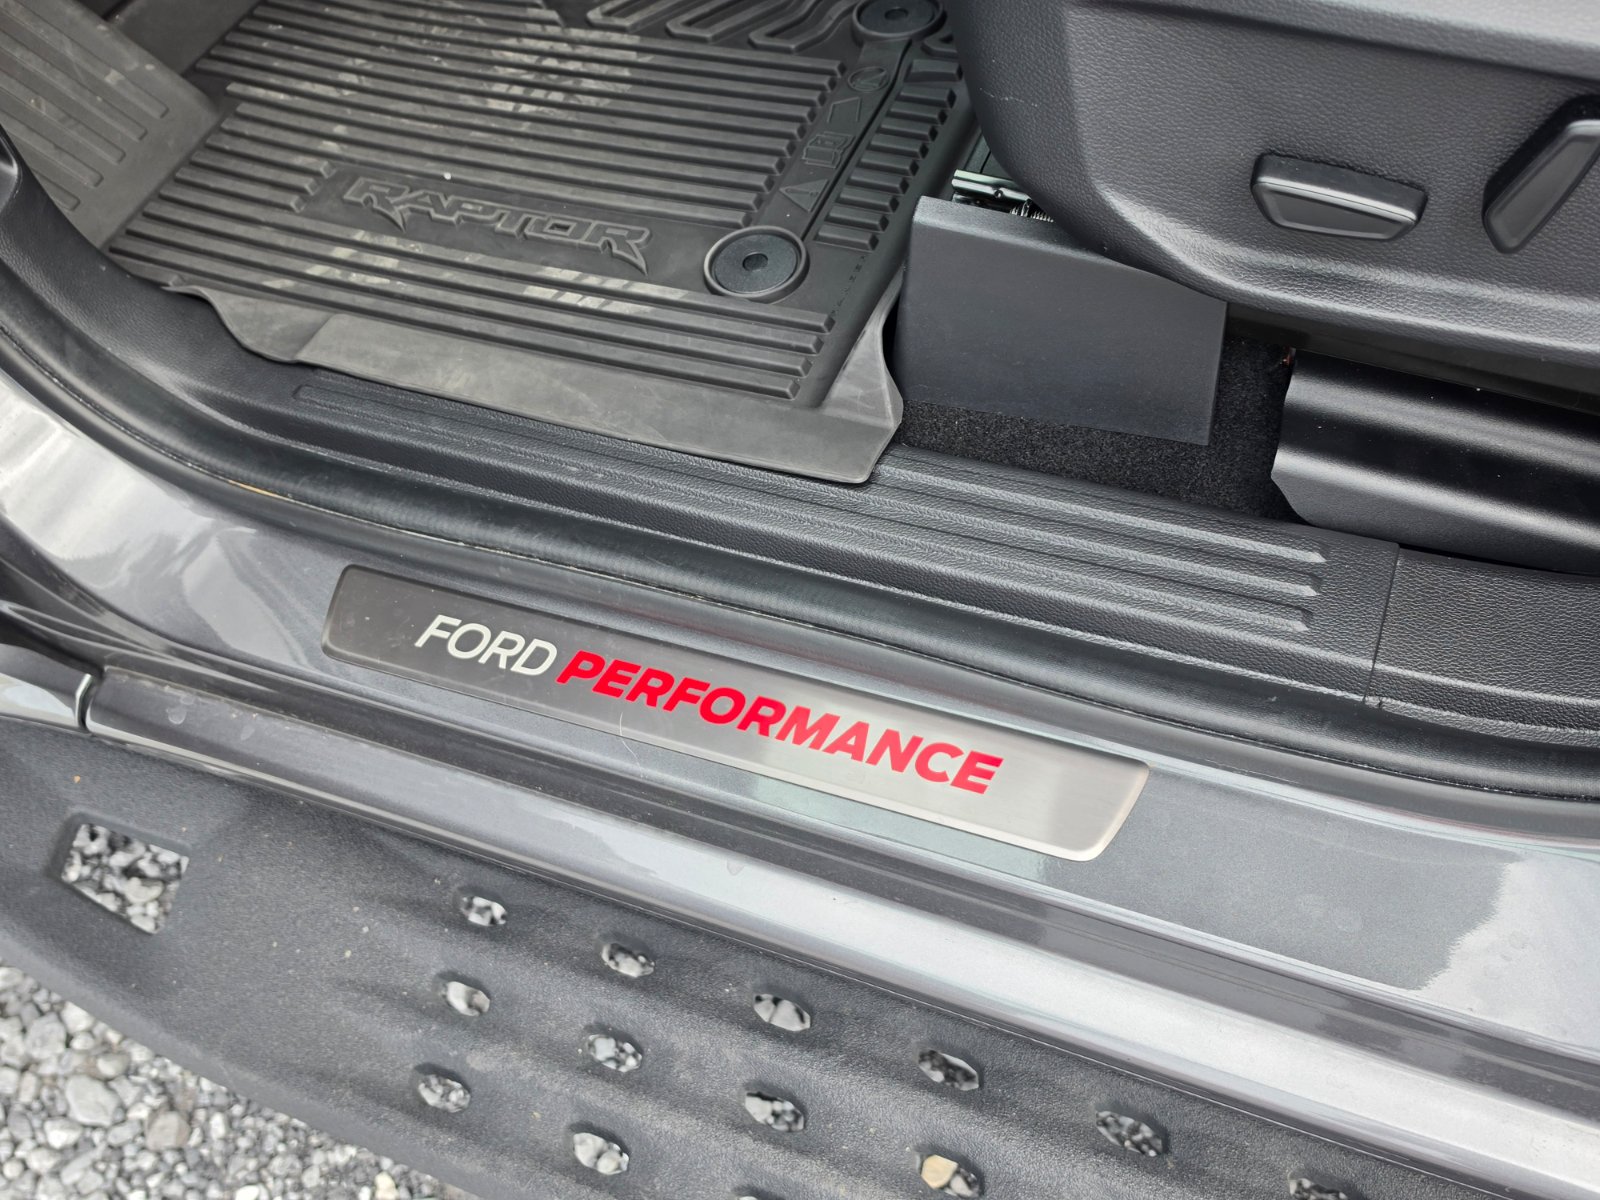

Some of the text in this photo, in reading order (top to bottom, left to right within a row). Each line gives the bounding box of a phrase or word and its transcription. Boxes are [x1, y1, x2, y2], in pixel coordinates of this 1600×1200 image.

[343, 177, 649, 276] RAPTOR
[414, 614, 1003, 794] FORD PERFORMANCE
